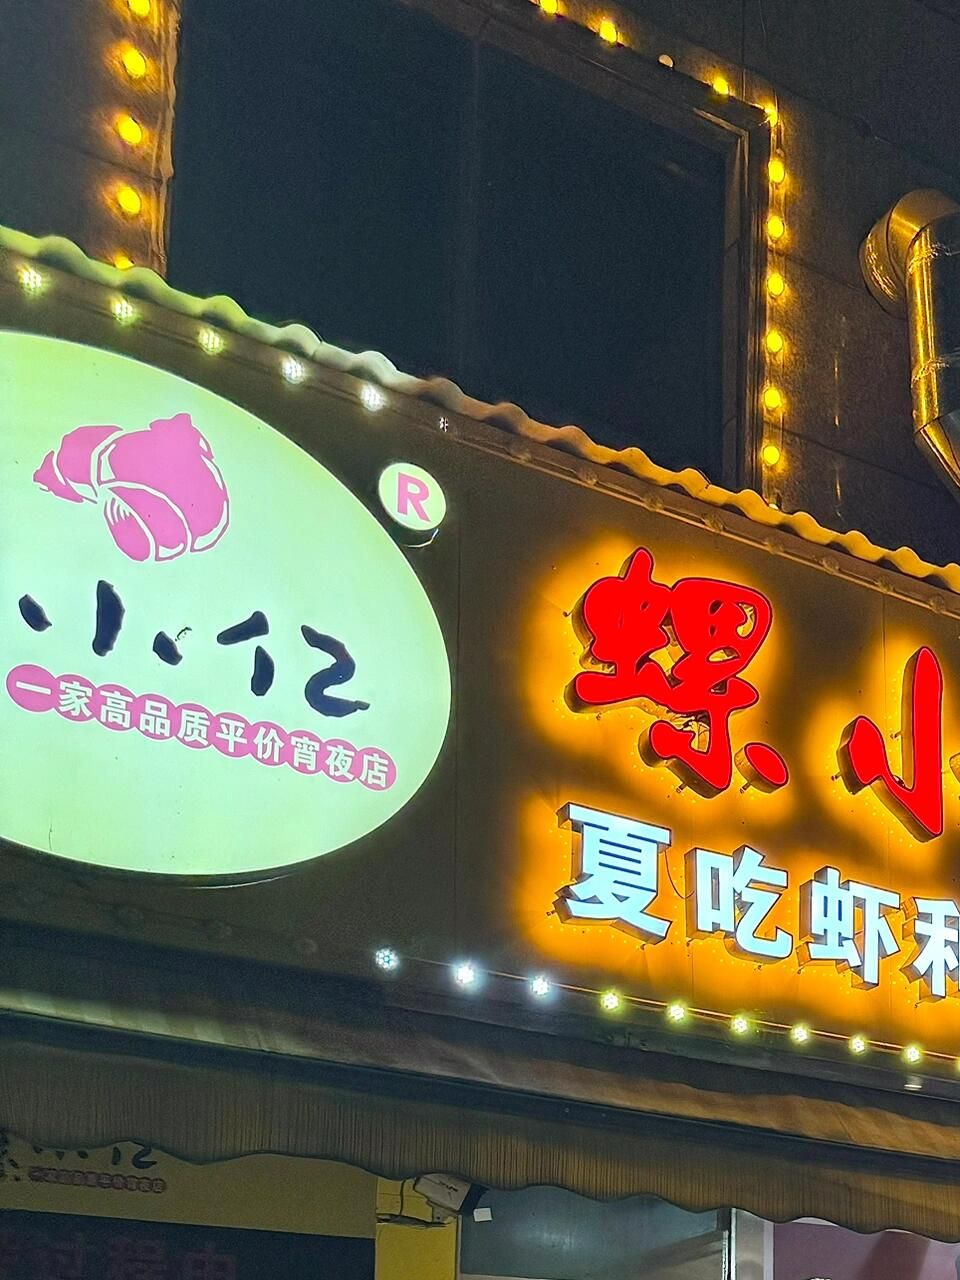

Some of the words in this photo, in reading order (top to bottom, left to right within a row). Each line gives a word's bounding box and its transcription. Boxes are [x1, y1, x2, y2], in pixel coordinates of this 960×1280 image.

[18, 579, 371, 717] 小亿
[16, 681, 390, 788] 一家高品质平价宵夜店
